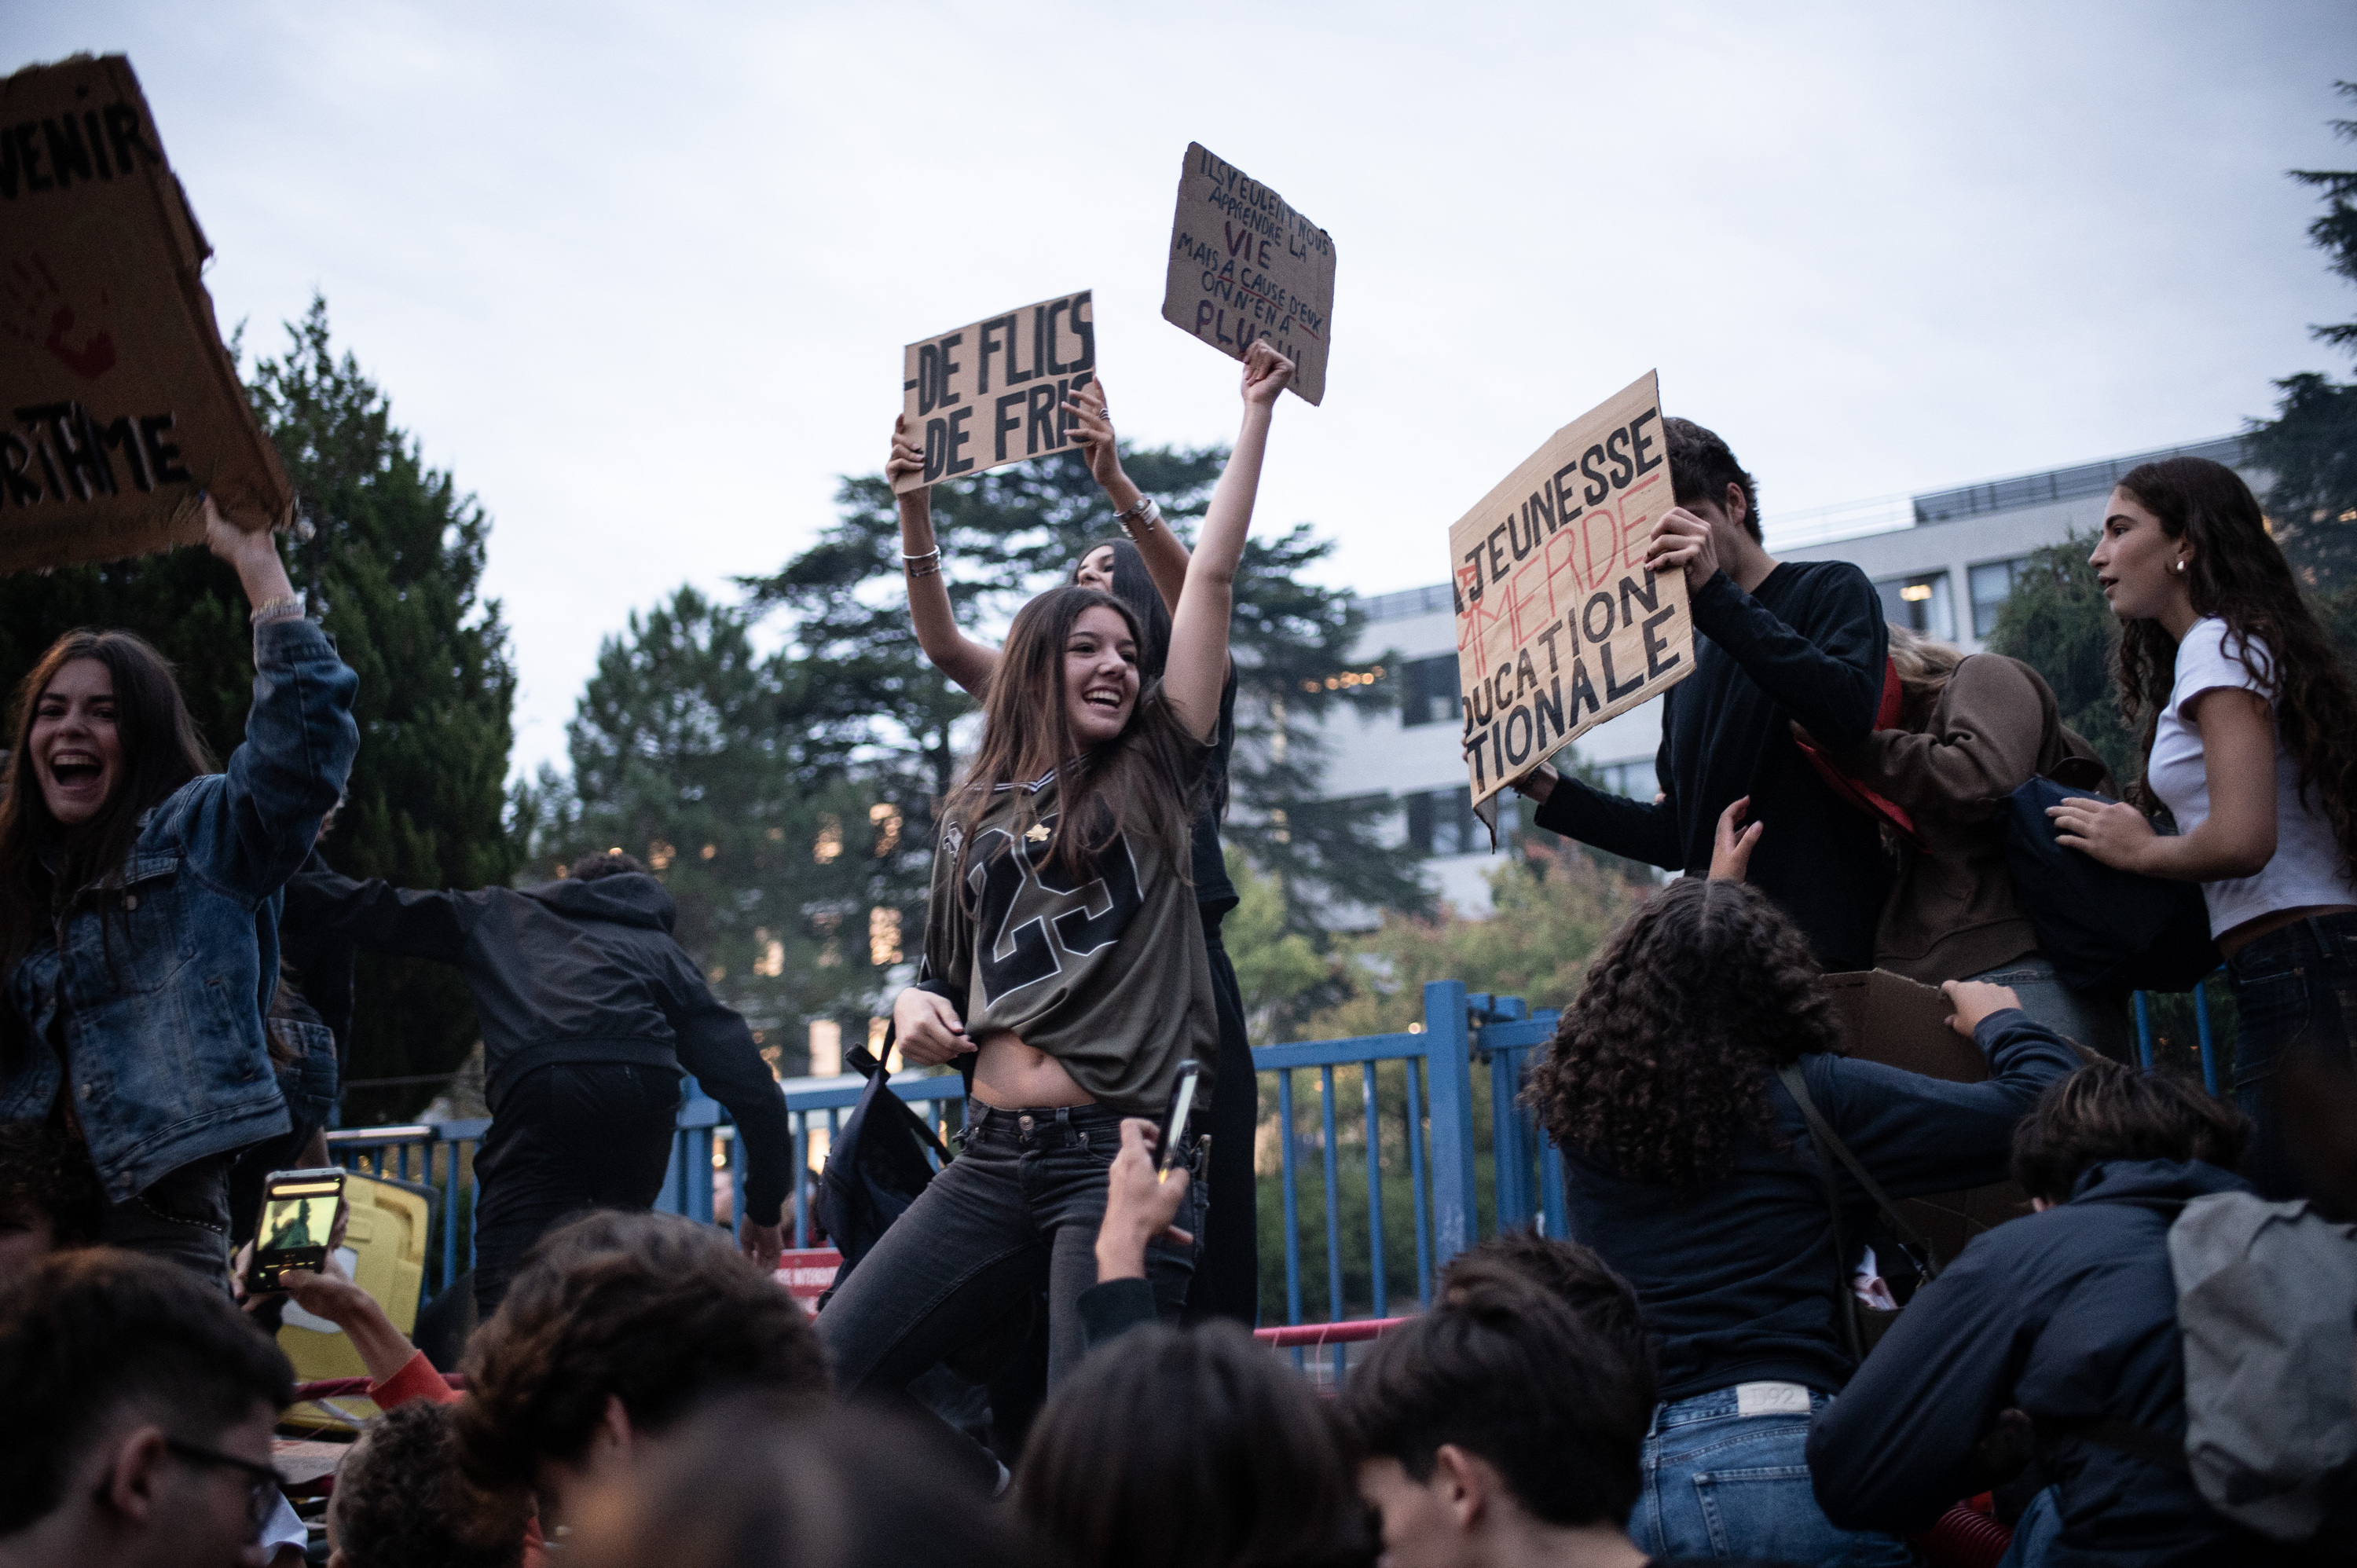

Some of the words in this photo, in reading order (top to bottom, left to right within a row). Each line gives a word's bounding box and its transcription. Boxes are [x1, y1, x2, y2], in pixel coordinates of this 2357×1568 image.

[1208, 186, 1283, 247] APPRENDRE
[1289, 234, 1307, 263] LA
[1224, 221, 1271, 270] VIE
[1298, 219, 1329, 256] NOUS
[1176, 233, 1218, 271] MAIS
[1241, 268, 1285, 306] CAUSE
[1289, 295, 1322, 334] D'EUX
[1201, 271, 1233, 302] ON
[1233, 291, 1278, 326] N'EN
[1279, 315, 1290, 335] A
[977, 291, 1094, 396] FLICS
[922, 405, 975, 484] DE
[1465, 406, 1663, 603] JEUNESSE
[1466, 603, 1681, 794] TIONALE
